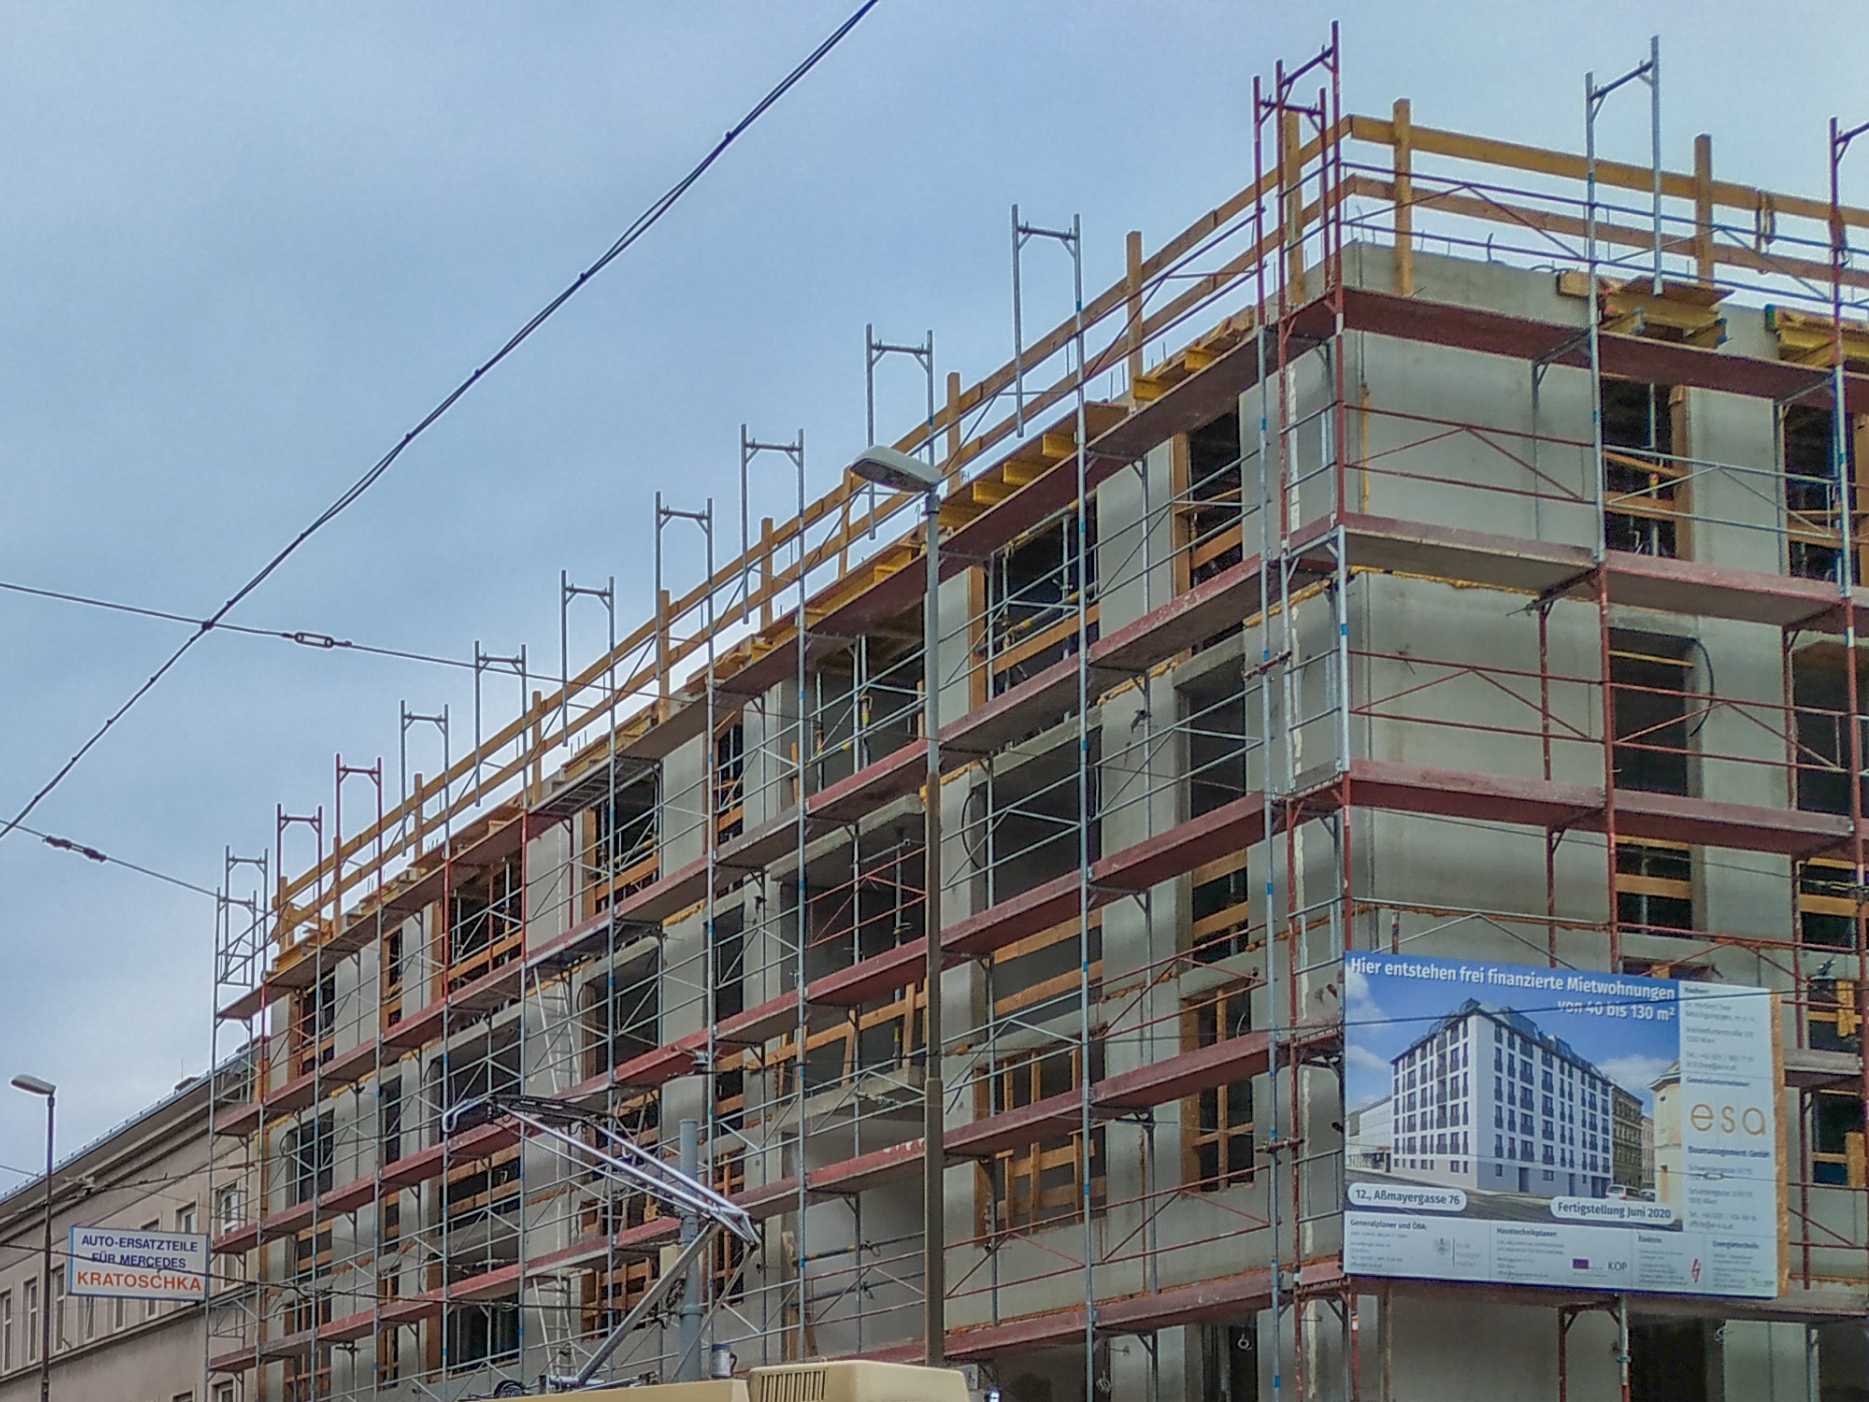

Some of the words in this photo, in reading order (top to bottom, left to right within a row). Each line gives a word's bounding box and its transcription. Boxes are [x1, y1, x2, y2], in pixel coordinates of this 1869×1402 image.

[1351, 956, 1381, 975] Hier
[1384, 962, 1457, 981] entstehen
[1459, 965, 1484, 983] frei
[1487, 967, 1564, 991] finanzierte
[1567, 975, 1676, 1001] Mietwohnungen
[1557, 1001, 1583, 1014] von
[1585, 1000, 1604, 1016] 40
[1606, 1000, 1628, 1018] bis
[1631, 1004, 1653, 1020] 130
[1656, 1007, 1676, 1021] m²
[1374, 1190, 1447, 1205] Aßmayergasse
[1448, 1195, 1461, 1205] 76
[1558, 1202, 1625, 1218] Fertigstellung
[1627, 1206, 1646, 1218] Juni
[1648, 1208, 1671, 1218] 2020
[81, 1235, 198, 1253] AUTO-ERSATZTEILE
[92, 1251, 116, 1263] FÜR
[119, 1254, 187, 1269] MERCEDES
[1607, 1261, 1628, 1272] KOP
[77, 1271, 202, 1291] KRATOSCHKA
